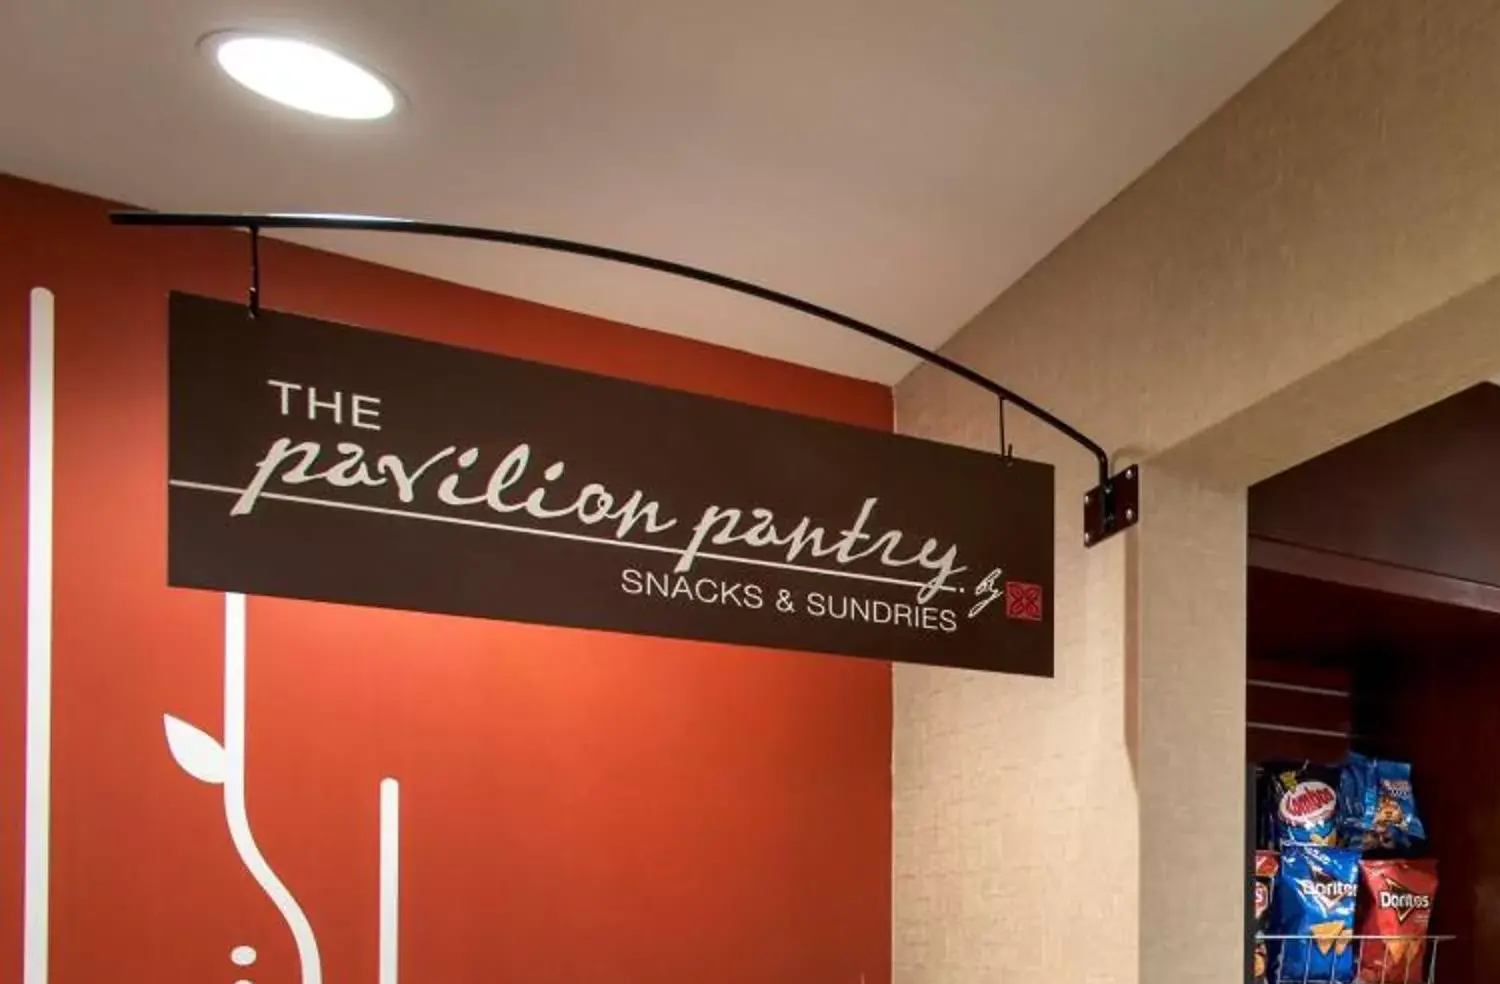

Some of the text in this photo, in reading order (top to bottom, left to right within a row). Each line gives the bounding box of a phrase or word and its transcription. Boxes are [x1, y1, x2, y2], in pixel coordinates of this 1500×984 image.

[267, 379, 383, 432] THE
[229, 432, 677, 536] pavilion
[620, 568, 958, 633] SNACKS & SUNDRIES
[1380, 892, 1429, 908] Doritos
